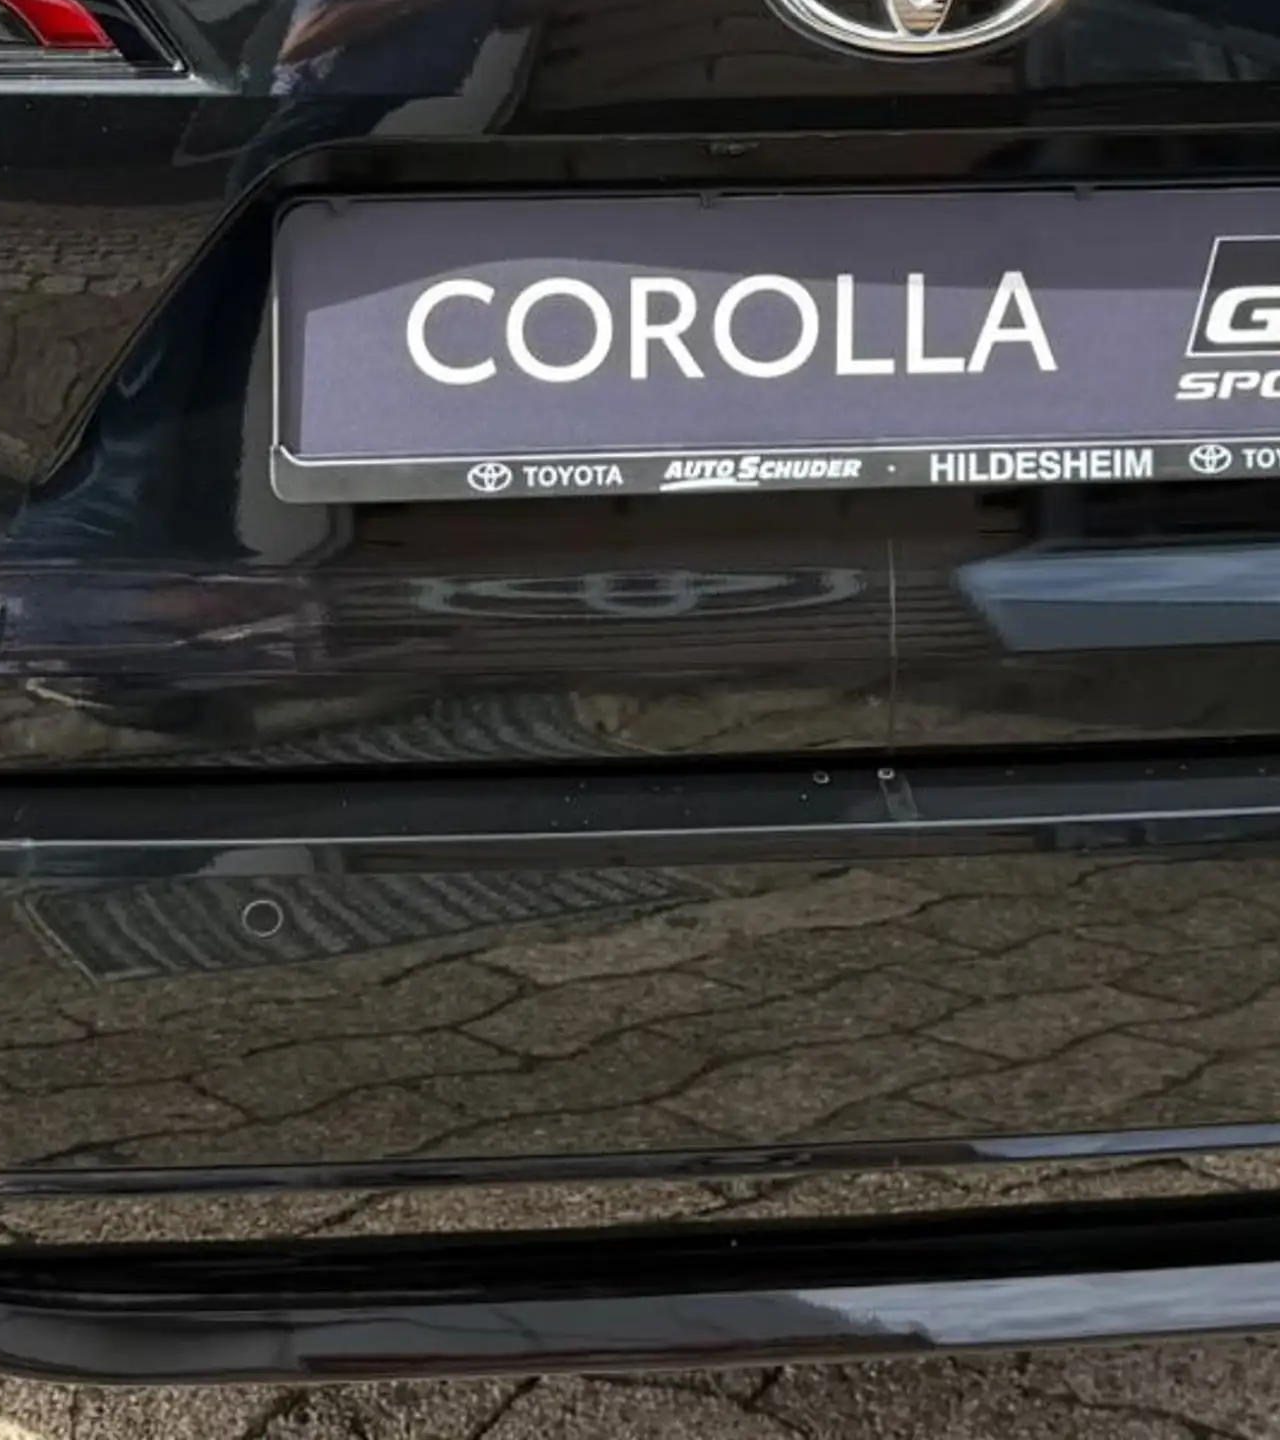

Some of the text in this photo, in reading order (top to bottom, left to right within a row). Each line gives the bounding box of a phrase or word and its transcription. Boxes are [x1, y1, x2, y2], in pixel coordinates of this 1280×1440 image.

[406, 270, 1058, 386] COROLLA
[523, 464, 624, 488] TOYOTA
[929, 447, 1154, 483] HILDESHEIM
